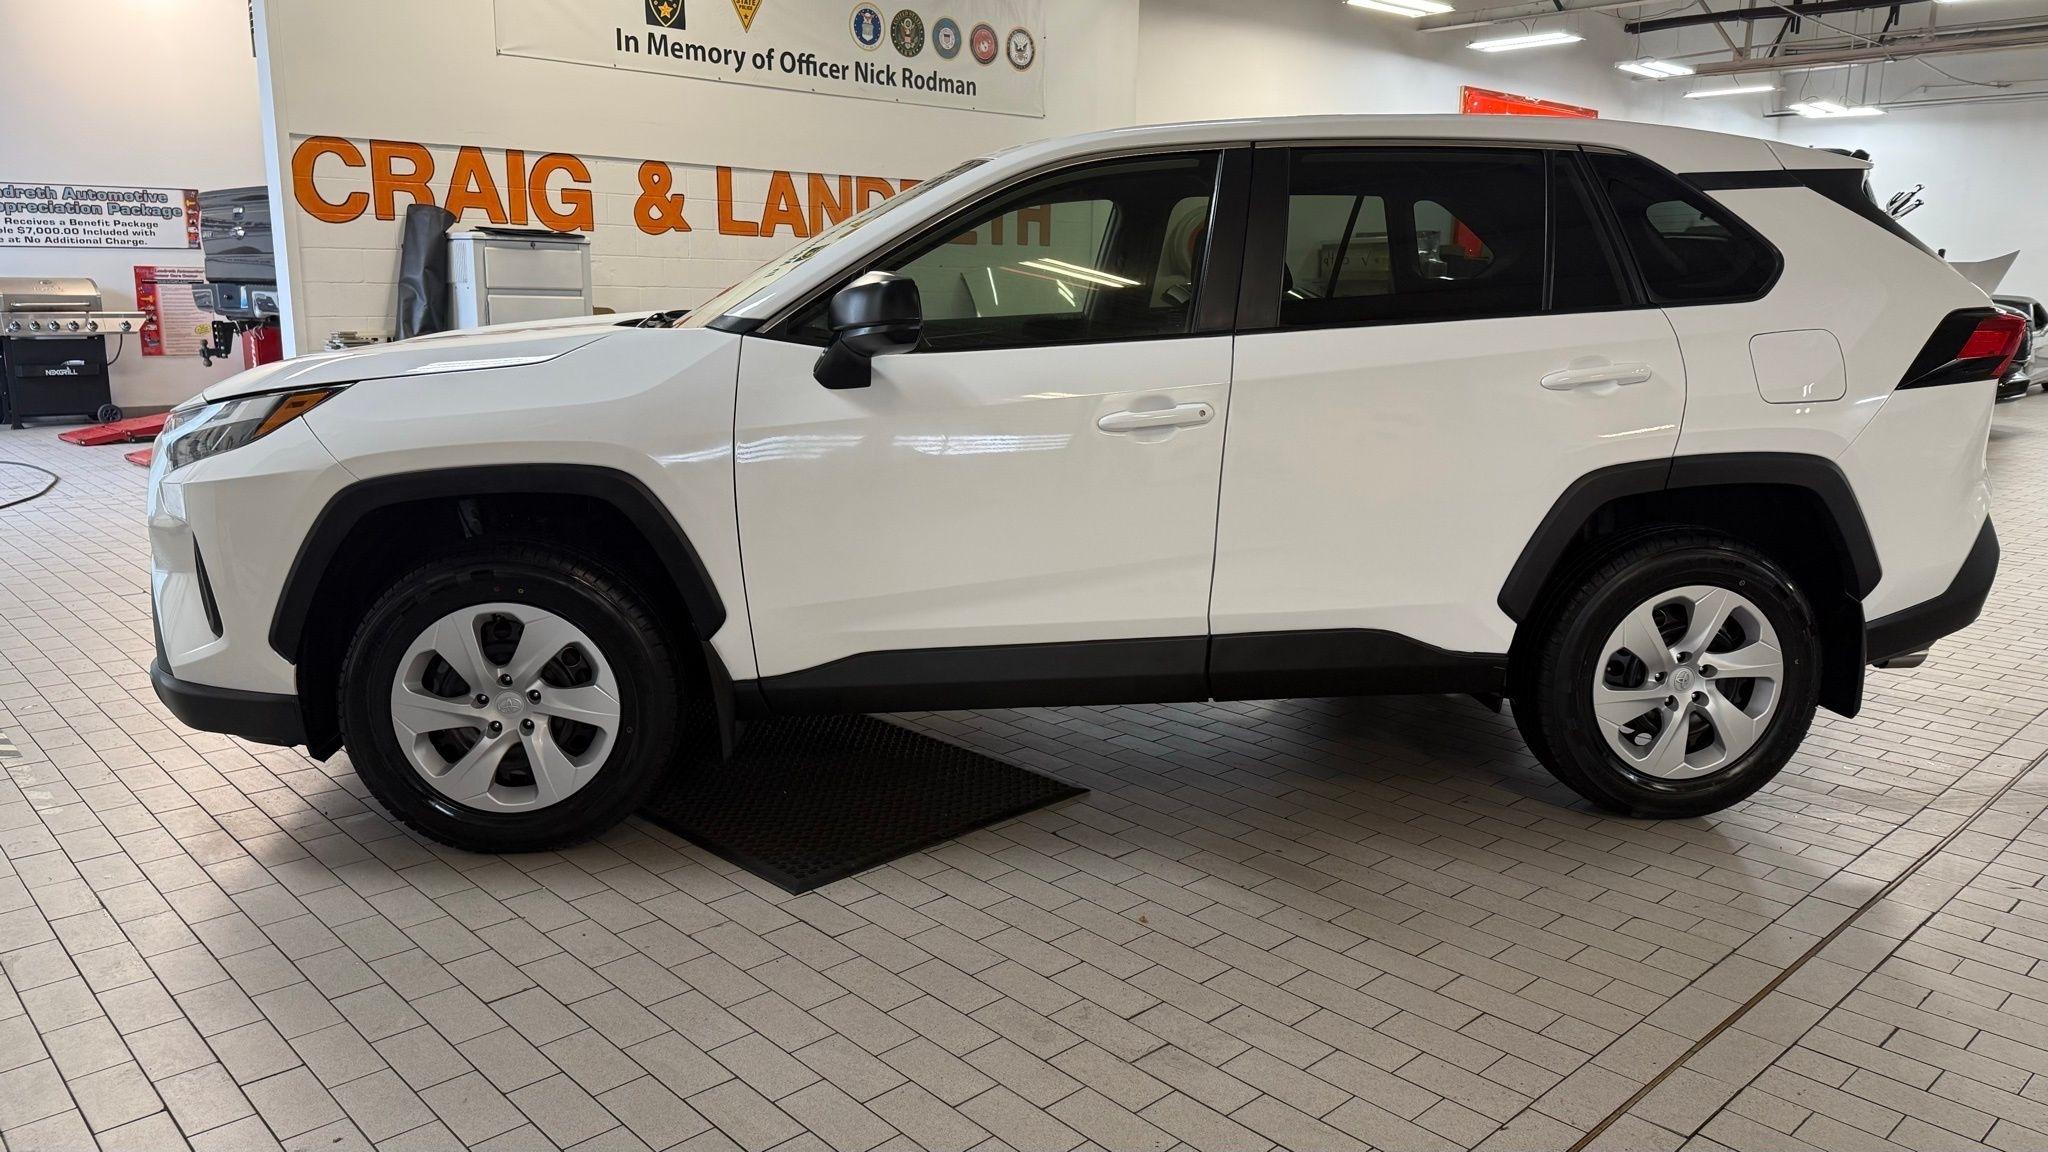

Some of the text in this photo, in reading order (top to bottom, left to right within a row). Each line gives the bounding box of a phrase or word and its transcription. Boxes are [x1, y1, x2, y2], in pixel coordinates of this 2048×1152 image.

[616, 28, 977, 96] In Memory of Officer Nick Rodman
[292, 135, 594, 232] CRAIG
[634, 160, 692, 235] &
[62, 187, 168, 203] Automotive
[107, 202, 183, 220] Package
[4, 217, 55, 226] Receives
[69, 219, 110, 227] Benefit
[113, 220, 159, 229] Package
[17, 227, 79, 235] $7,000.00
[83, 228, 129, 236] Included
[45, 236, 102, 244] Additional
[105, 237, 148, 246] Charge.
[45, 366, 78, 376] NEXGRILL
